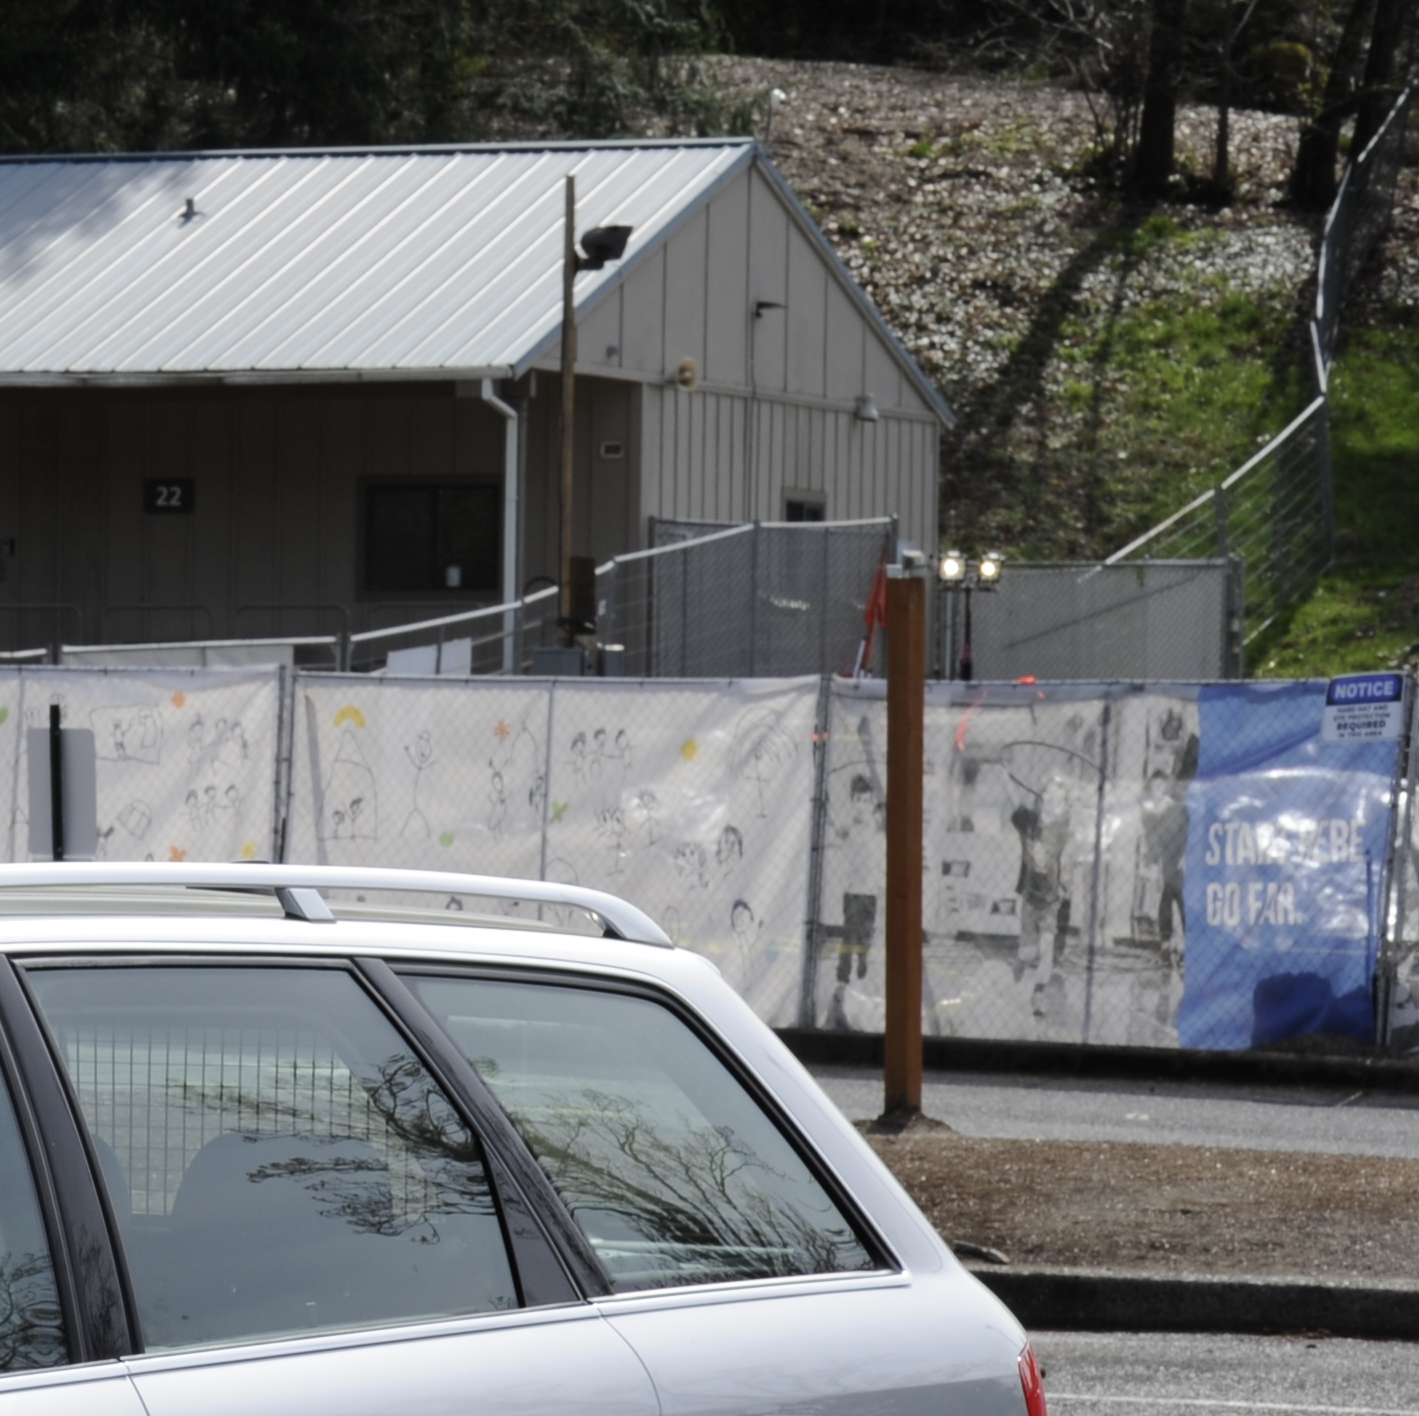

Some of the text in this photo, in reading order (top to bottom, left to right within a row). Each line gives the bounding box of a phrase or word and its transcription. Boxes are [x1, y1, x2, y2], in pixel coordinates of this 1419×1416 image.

[156, 486, 181, 506] 22
[1334, 680, 1394, 699] NOTICE
[1336, 720, 1387, 731] REQUIRED
[1206, 882, 1241, 926] GO
